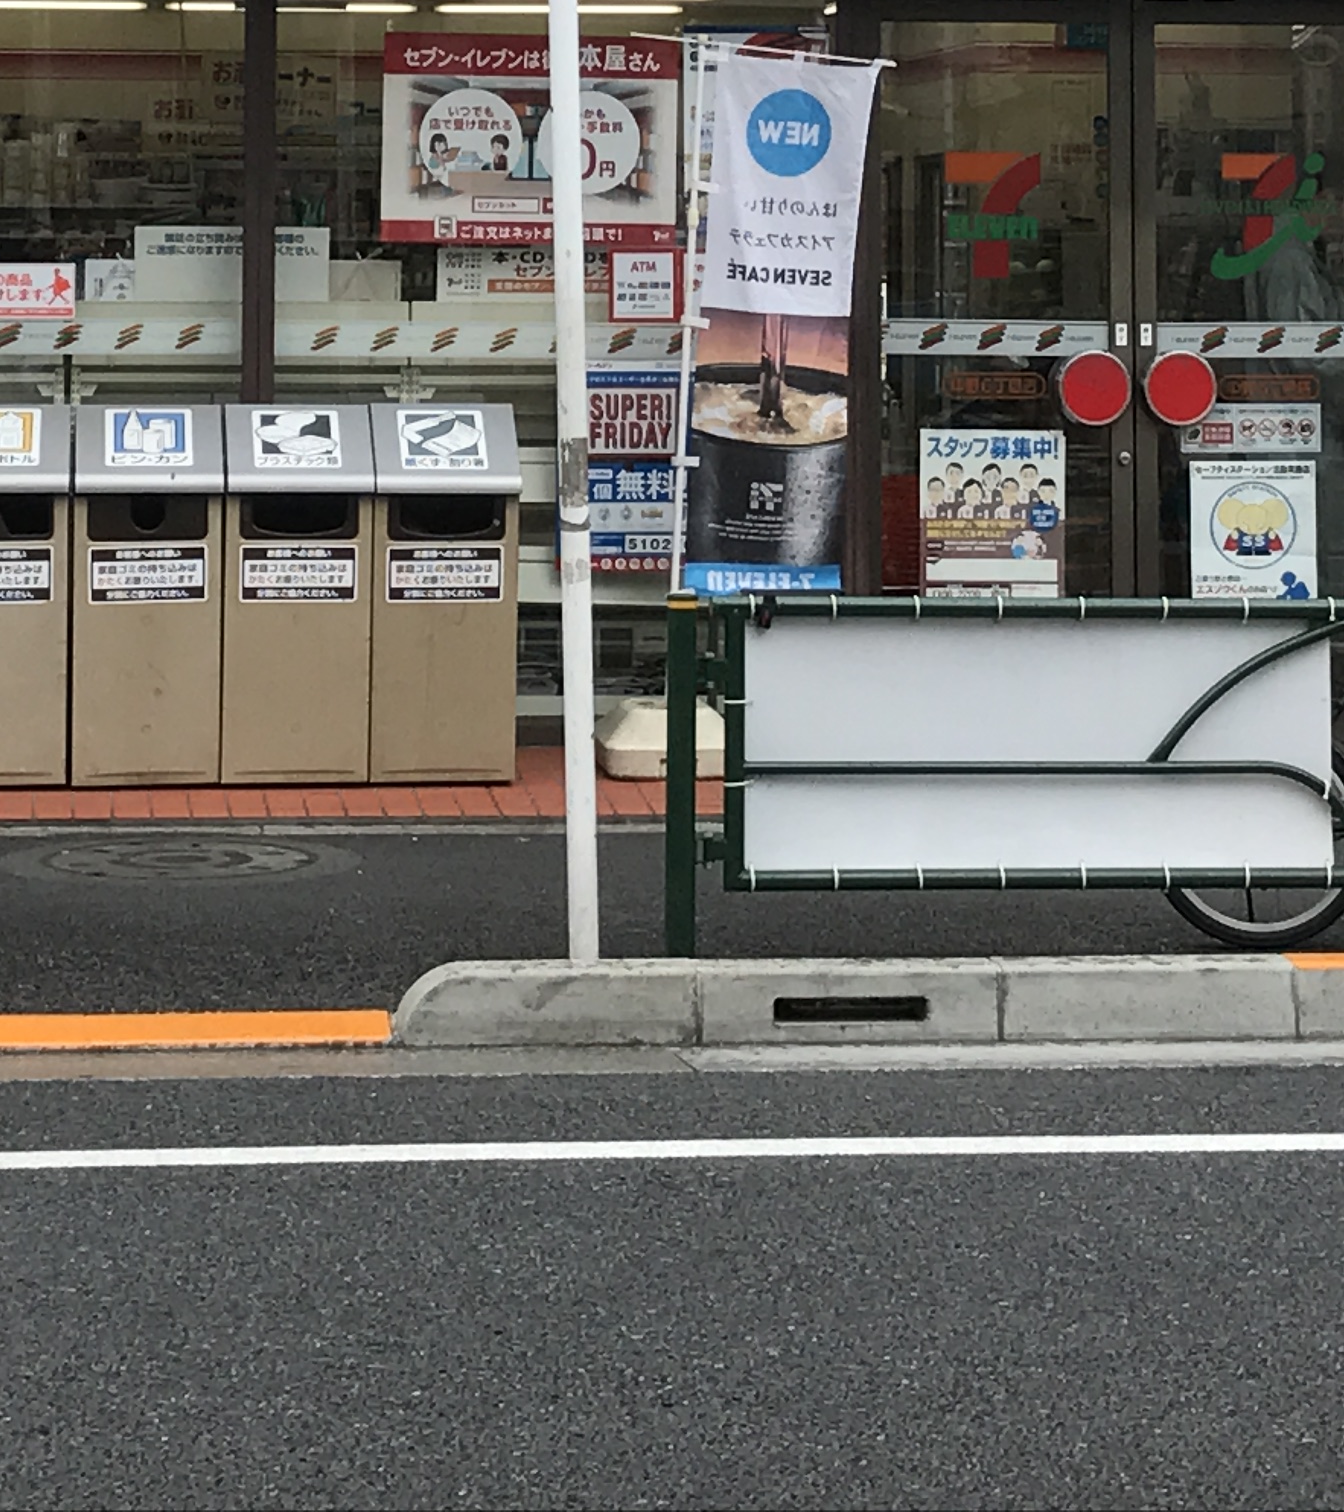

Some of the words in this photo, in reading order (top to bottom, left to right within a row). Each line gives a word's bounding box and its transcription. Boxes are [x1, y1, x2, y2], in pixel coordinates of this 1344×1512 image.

[448, 104, 495, 118] いつでも
[428, 118, 514, 132] 店で受け取れる
[630, 260, 657, 274] ATM
[589, 422, 673, 450] FRIDAY
[926, 436, 1059, 460] スタッフ募集中!
